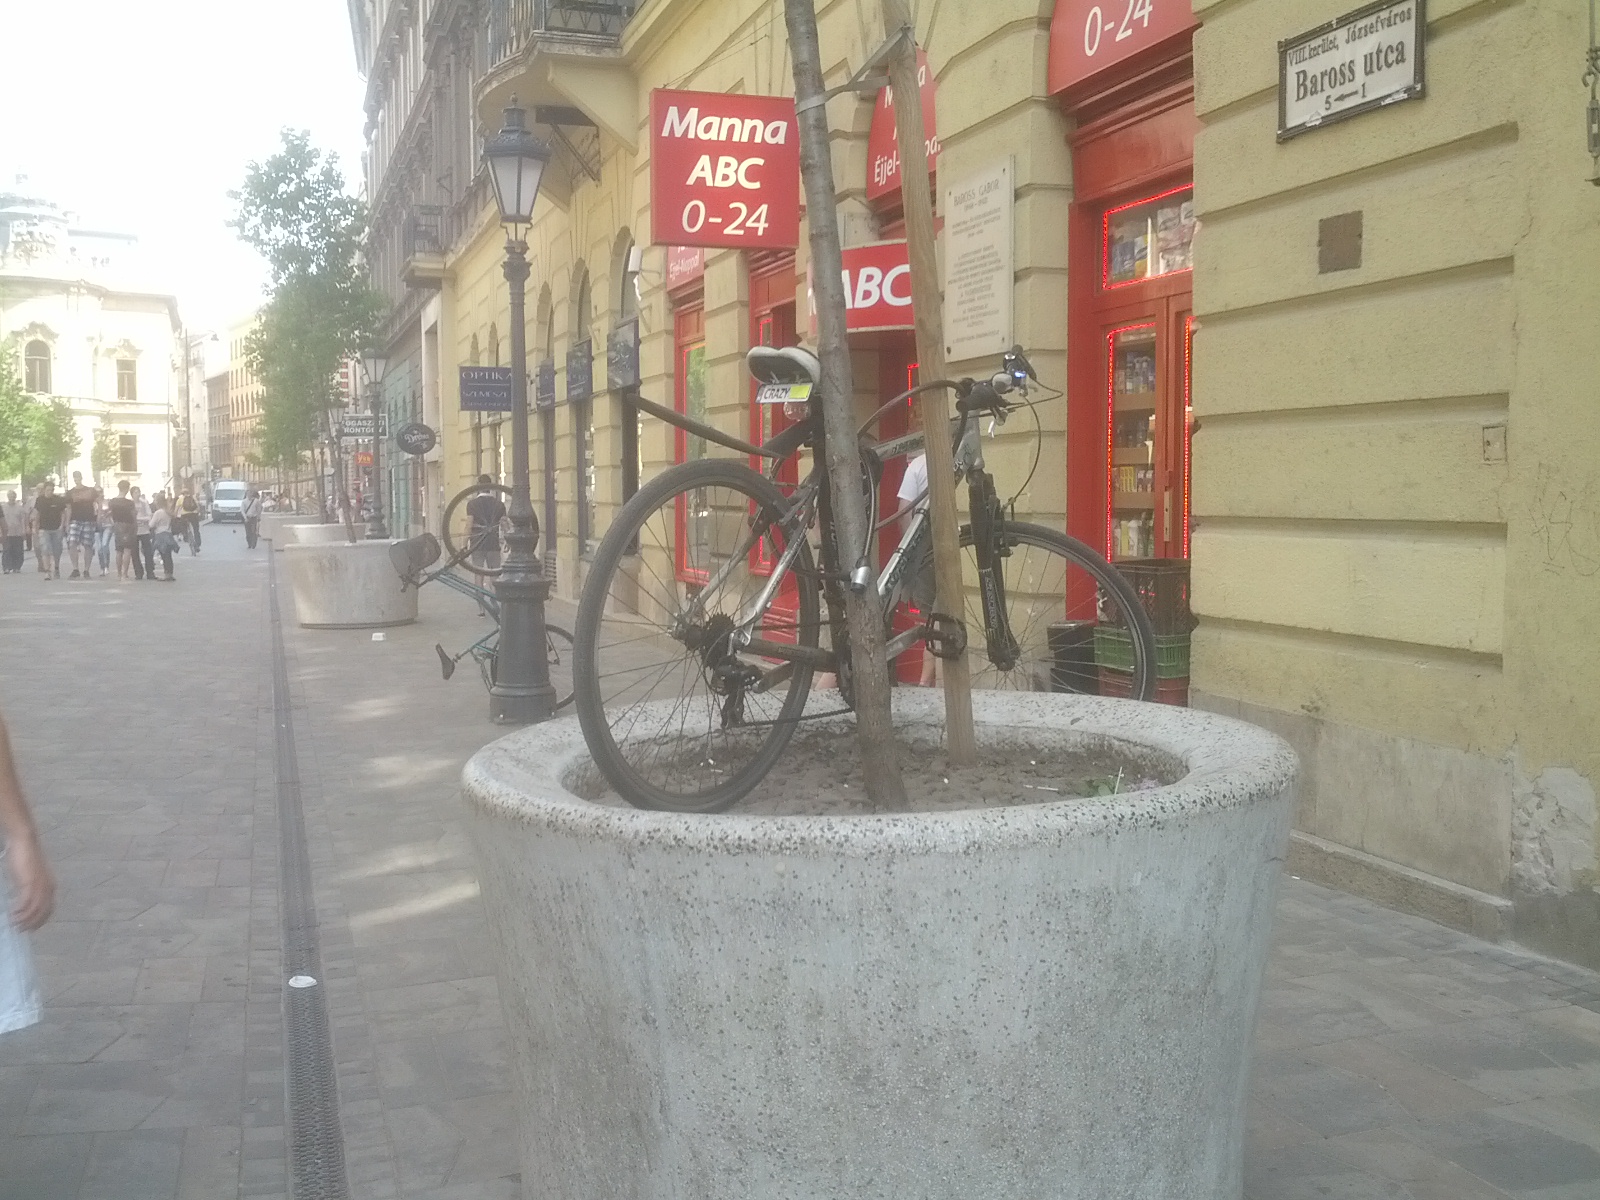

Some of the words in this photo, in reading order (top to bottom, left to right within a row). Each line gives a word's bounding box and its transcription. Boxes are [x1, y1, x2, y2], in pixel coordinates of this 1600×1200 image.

[1084, 0, 1153, 57] 0-24
[1344, 7, 1412, 45] Józsefváros
[1295, 57, 1356, 103] Baross
[1363, 40, 1406, 77] utca
[1324, 94, 1332, 111] 5
[661, 105, 788, 145] Manna
[685, 154, 765, 190] ABC
[681, 199, 769, 237] 0-24
[763, 387, 791, 400] CRAZY
